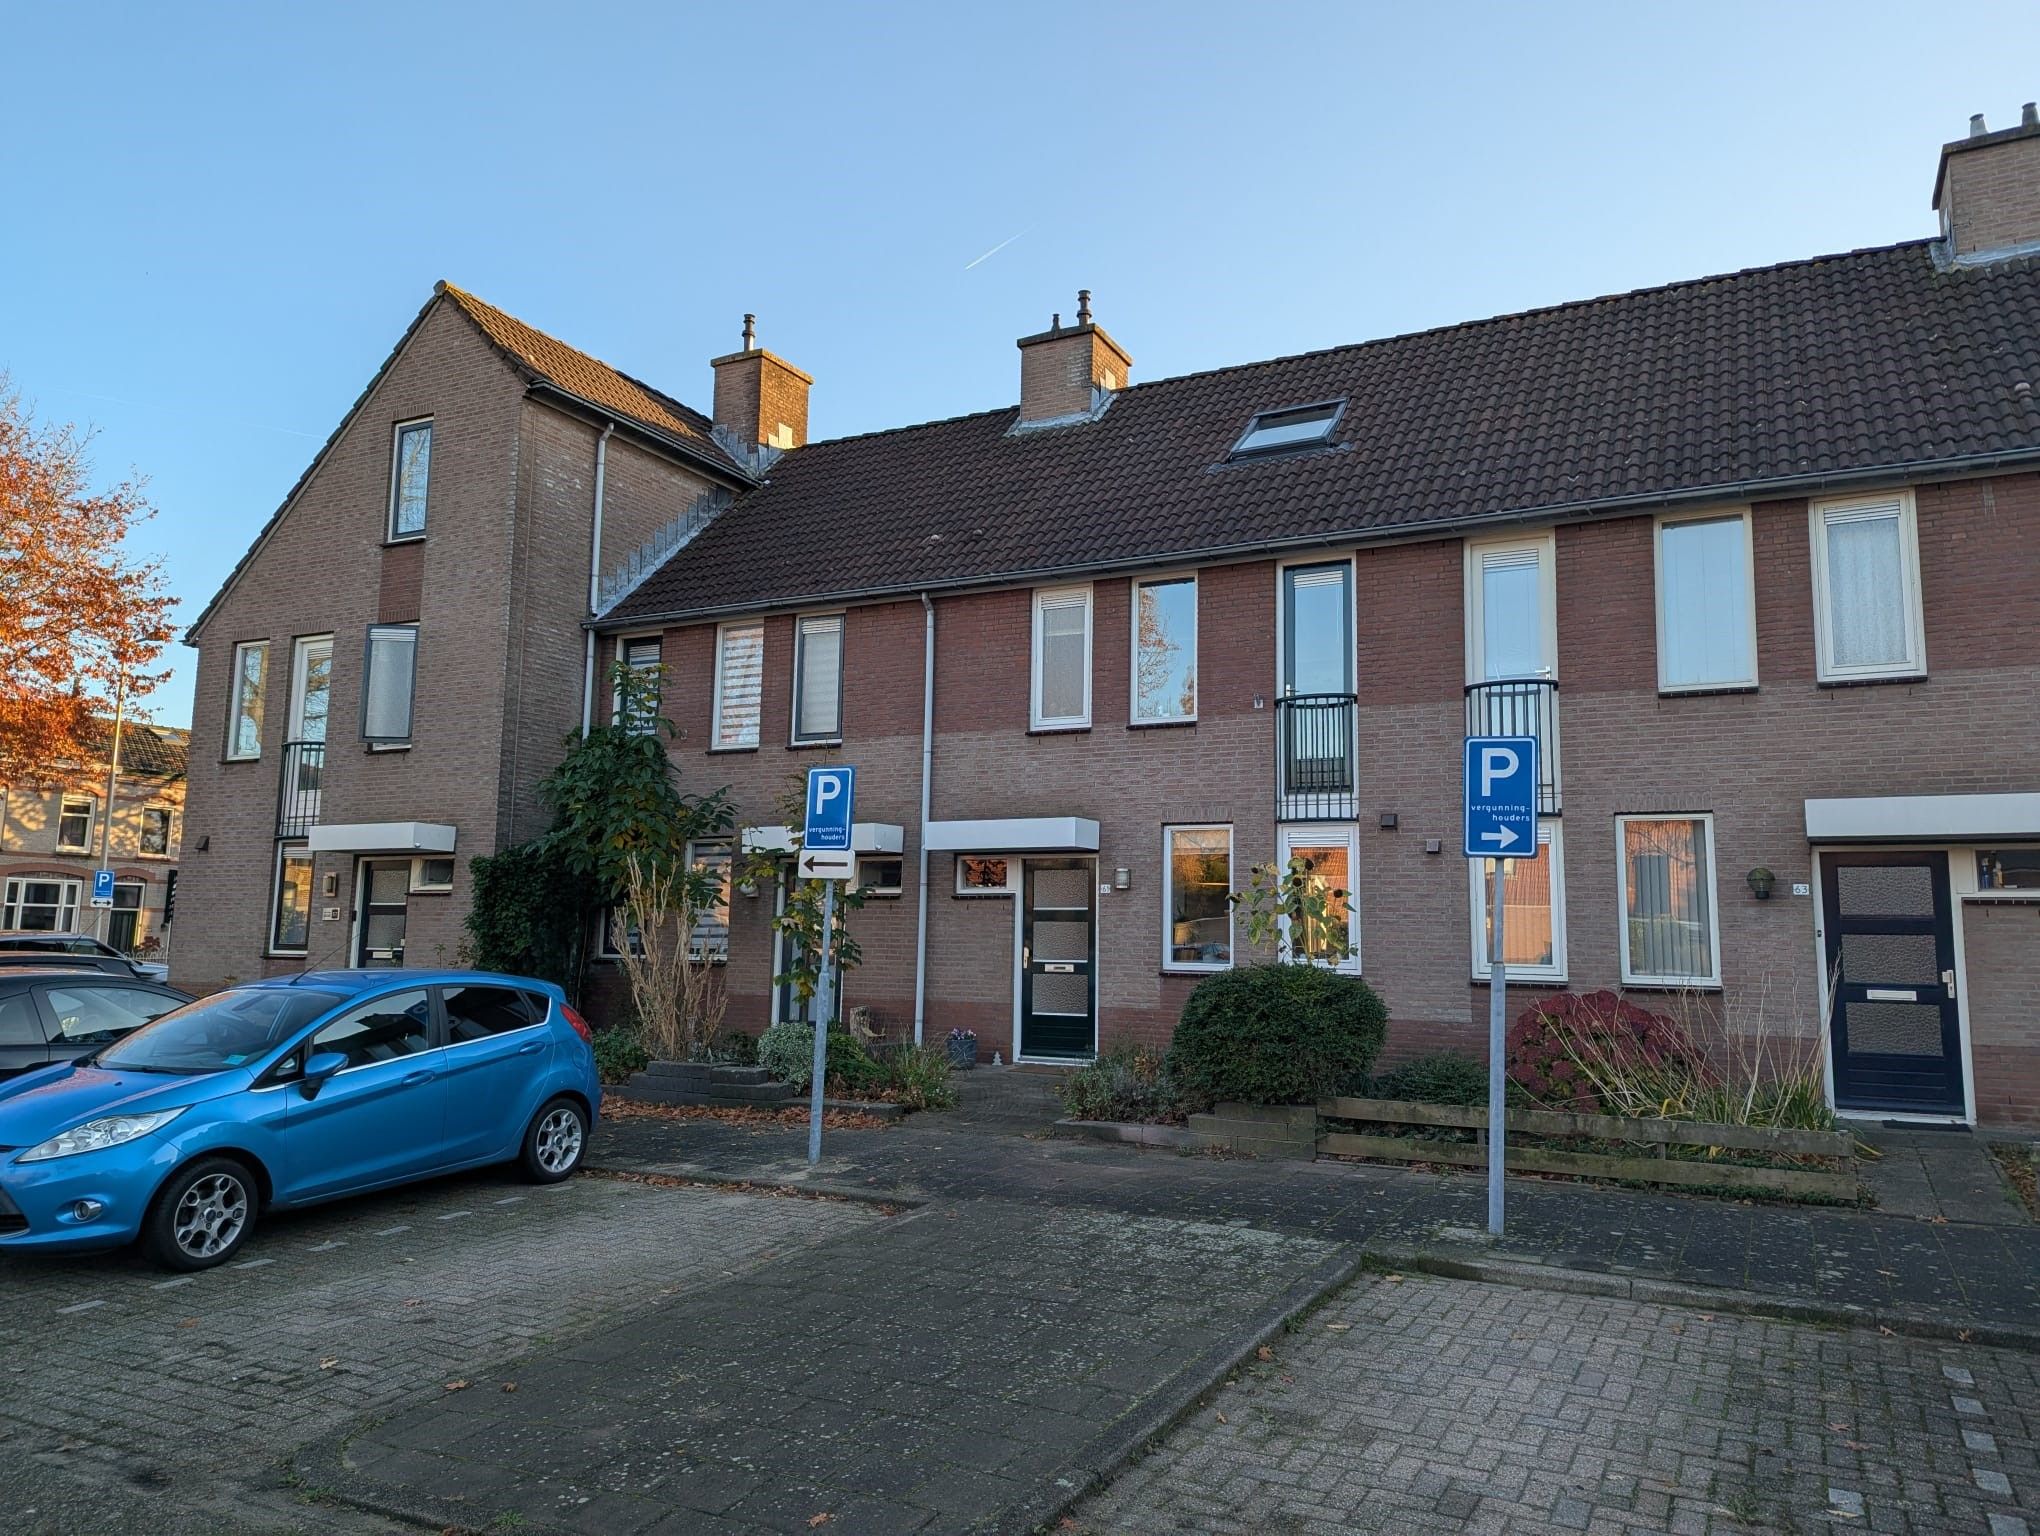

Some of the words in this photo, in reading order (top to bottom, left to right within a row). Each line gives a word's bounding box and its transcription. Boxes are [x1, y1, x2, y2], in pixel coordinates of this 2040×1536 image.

[1481, 747, 1520, 797] P
[816, 775, 841, 815] P
[1470, 804, 1531, 813] vergunning-
[98, 873, 110, 888] P
[1794, 885, 1808, 894] 63
